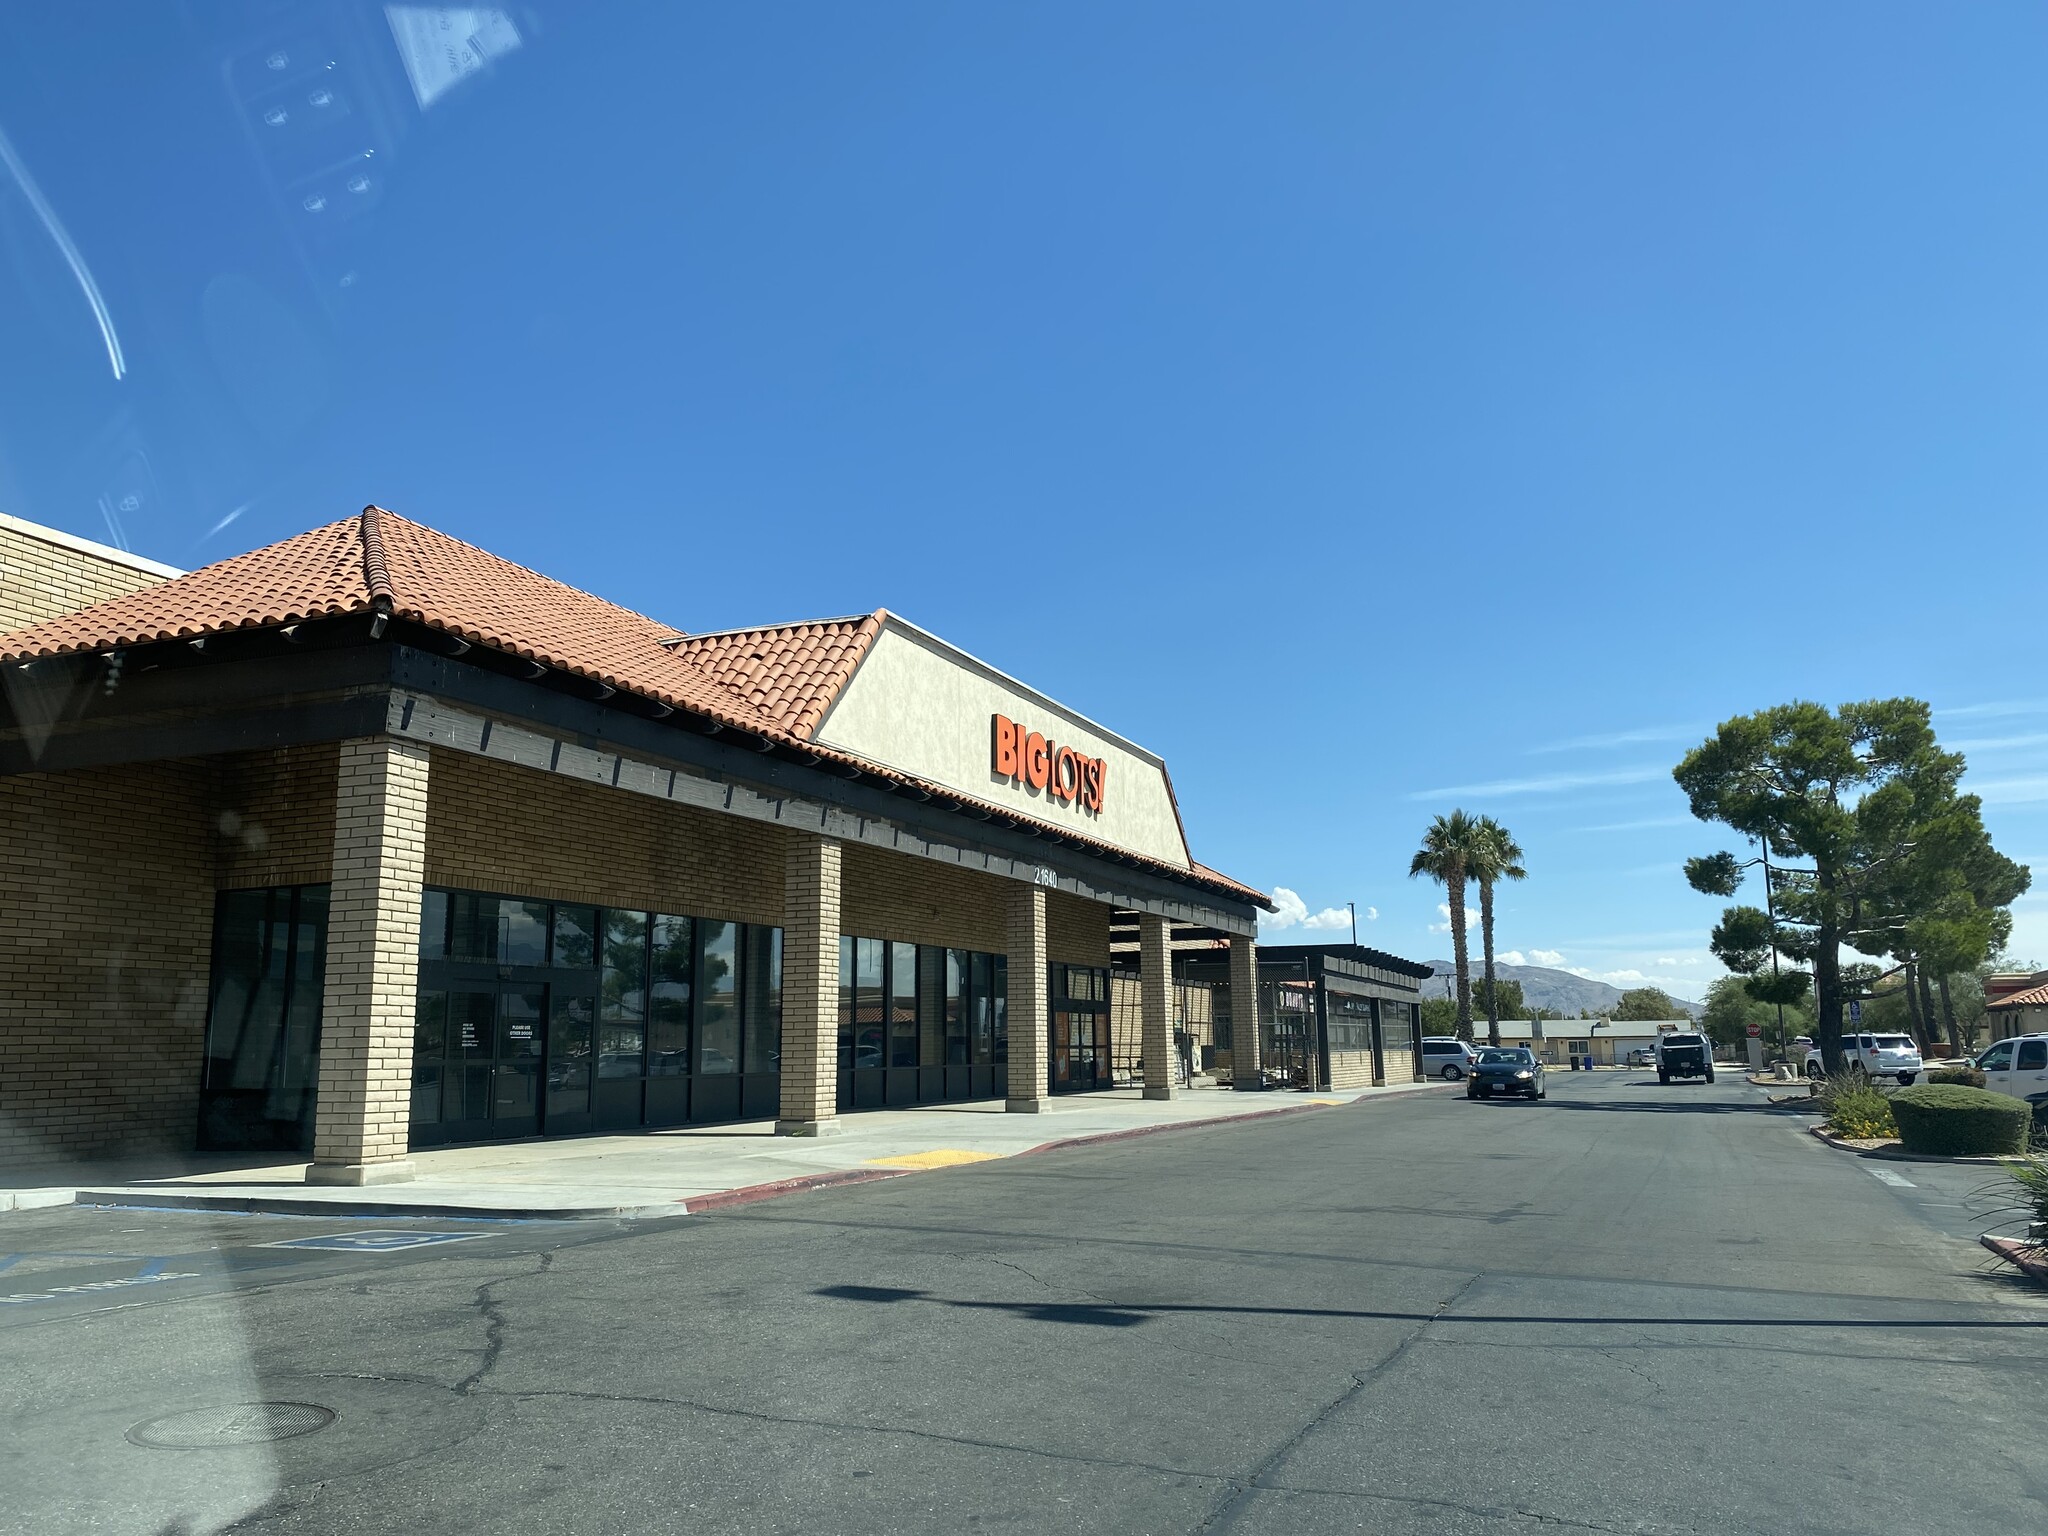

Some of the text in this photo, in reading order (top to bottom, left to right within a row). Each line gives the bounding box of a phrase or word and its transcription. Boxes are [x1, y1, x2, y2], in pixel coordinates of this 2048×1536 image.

[991, 713, 1108, 814] BIG LOTS!
[1034, 867, 1057, 888] 21640
